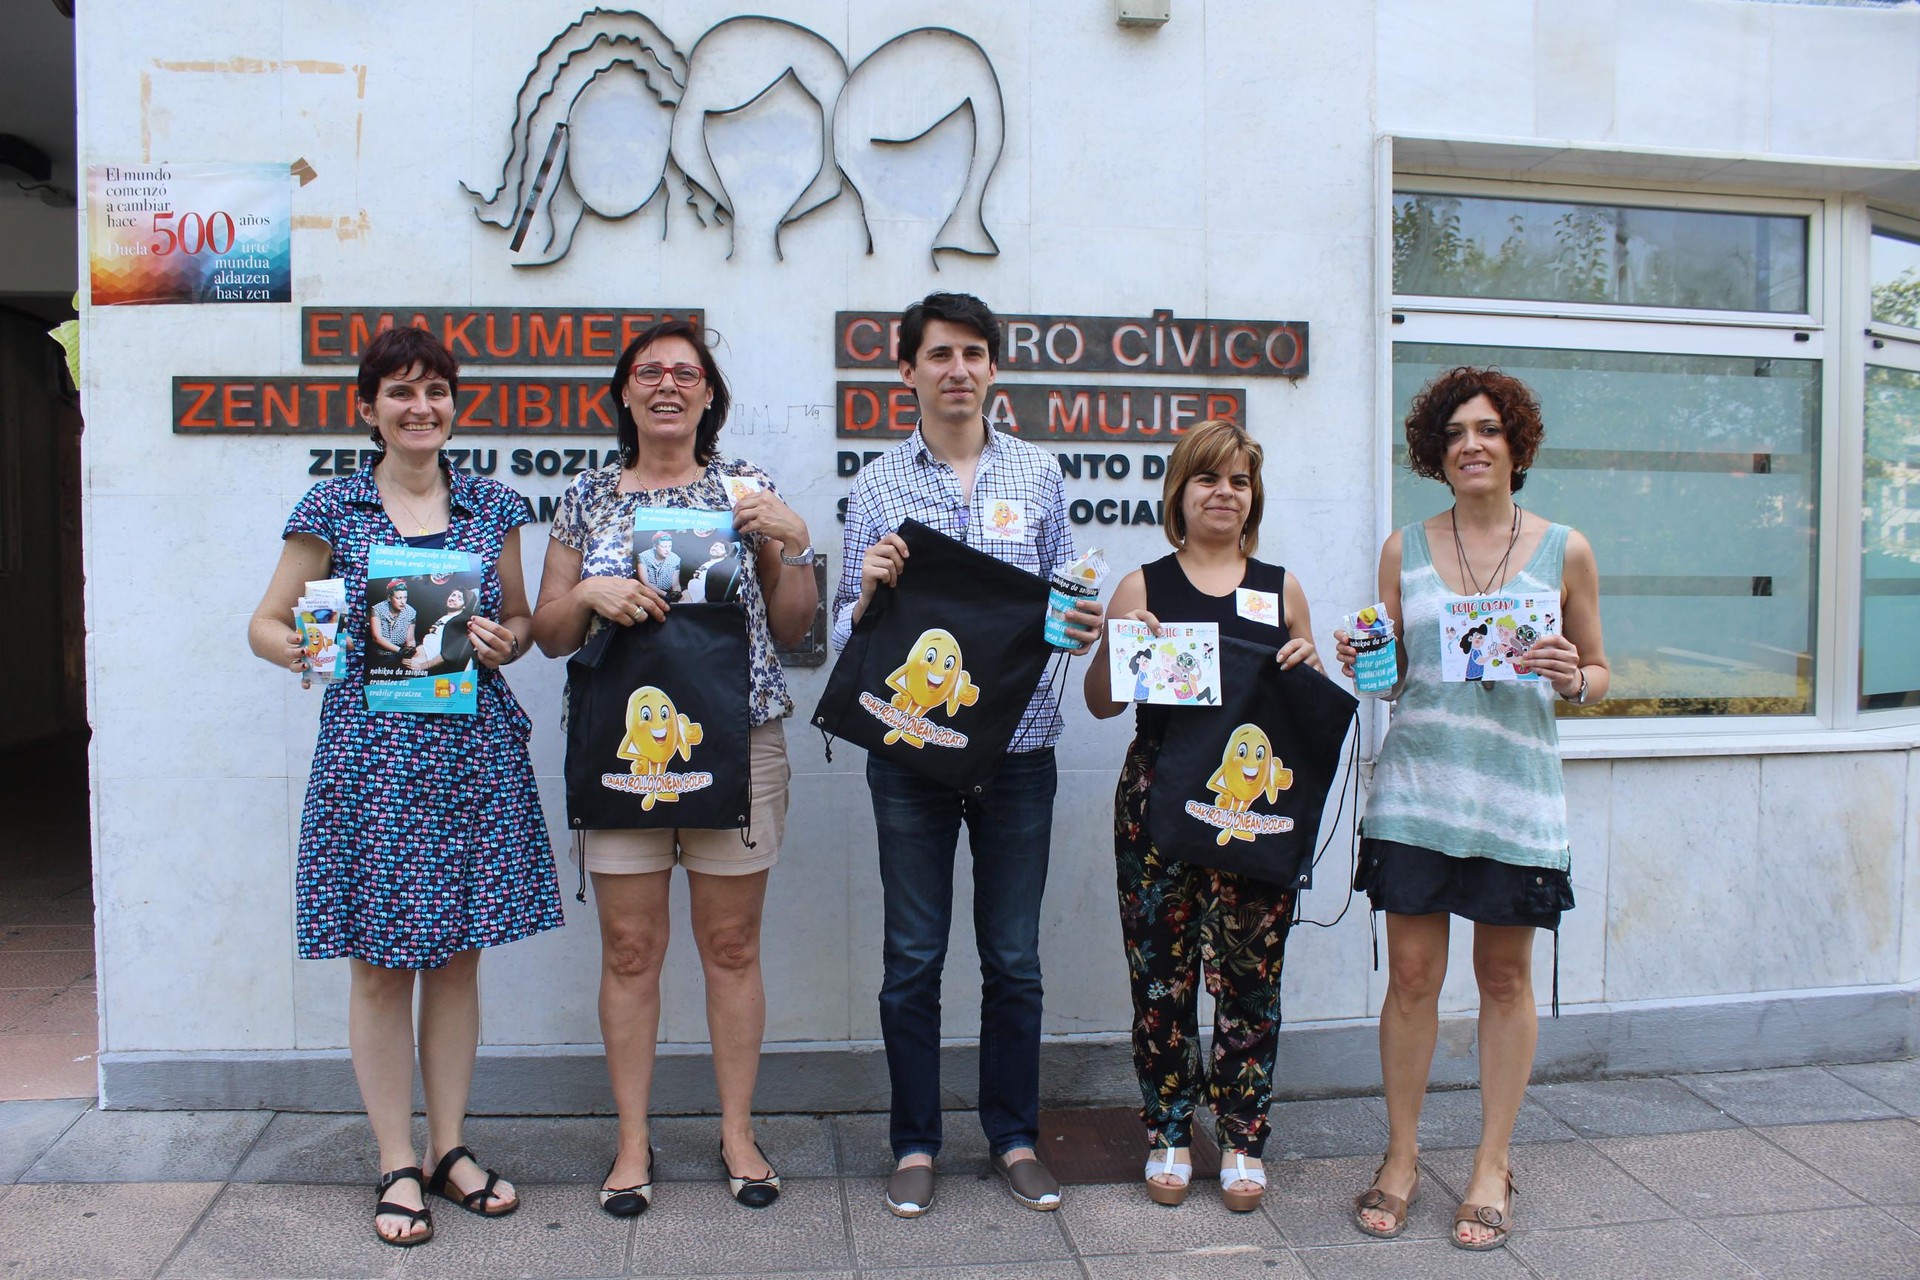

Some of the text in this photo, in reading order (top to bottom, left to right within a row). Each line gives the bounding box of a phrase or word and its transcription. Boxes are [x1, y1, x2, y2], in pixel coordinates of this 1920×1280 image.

[106, 167, 171, 181] El mundo
[106, 184, 167, 196] comenzó
[106, 199, 170, 212] a cambiar
[107, 211, 270, 256] hace 500 años
[108, 242, 269, 256] Duela urte
[215, 255, 270, 269] mundua
[214, 270, 270, 284] aldatzen
[217, 286, 270, 300] hasi zen
[309, 312, 698, 357] EMKUMEE
[1112, 314, 1303, 369] CÍVICO
[179, 382, 616, 428] ZENT ZIBIK
[844, 387, 916, 431] DE
[1048, 390, 1239, 435] MUJER
[604, 774, 711, 792] JAIAK ROLLO ONEAN GOZATU
